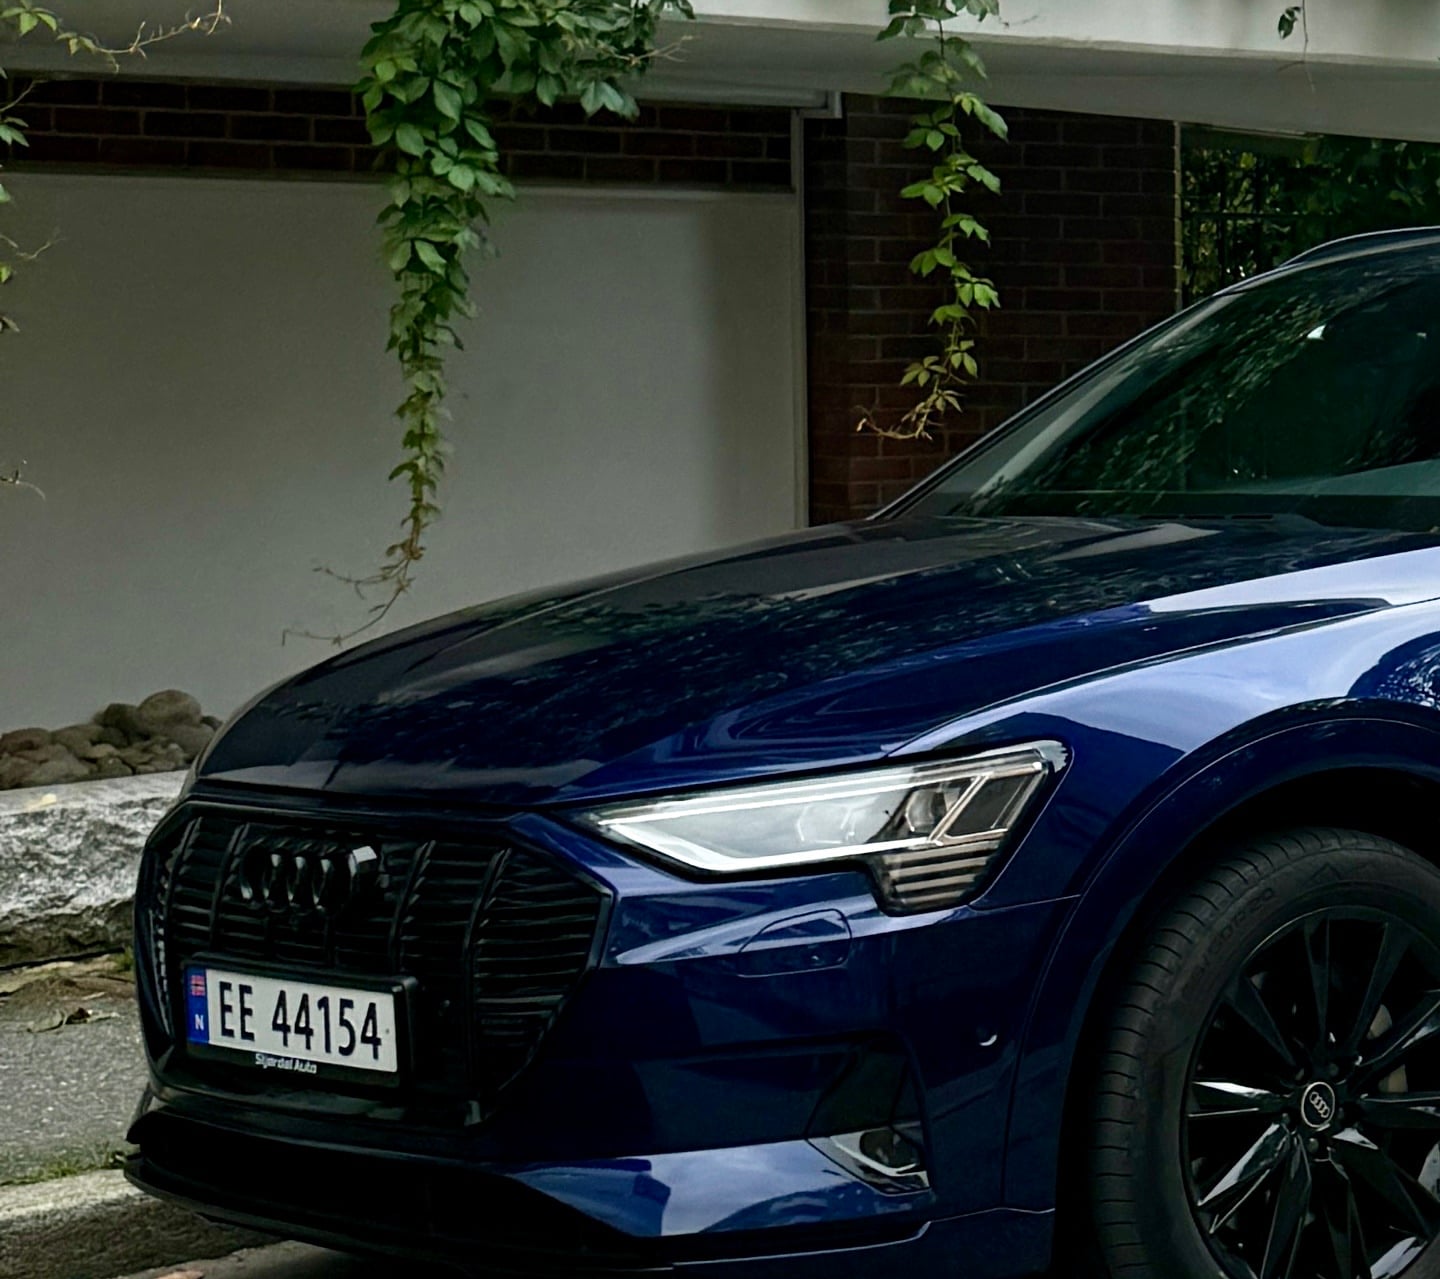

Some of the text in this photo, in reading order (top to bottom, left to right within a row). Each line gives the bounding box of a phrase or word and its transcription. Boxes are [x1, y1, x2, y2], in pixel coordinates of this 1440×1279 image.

[194, 1013, 205, 1031] N
[219, 981, 383, 1061] EE 44154
